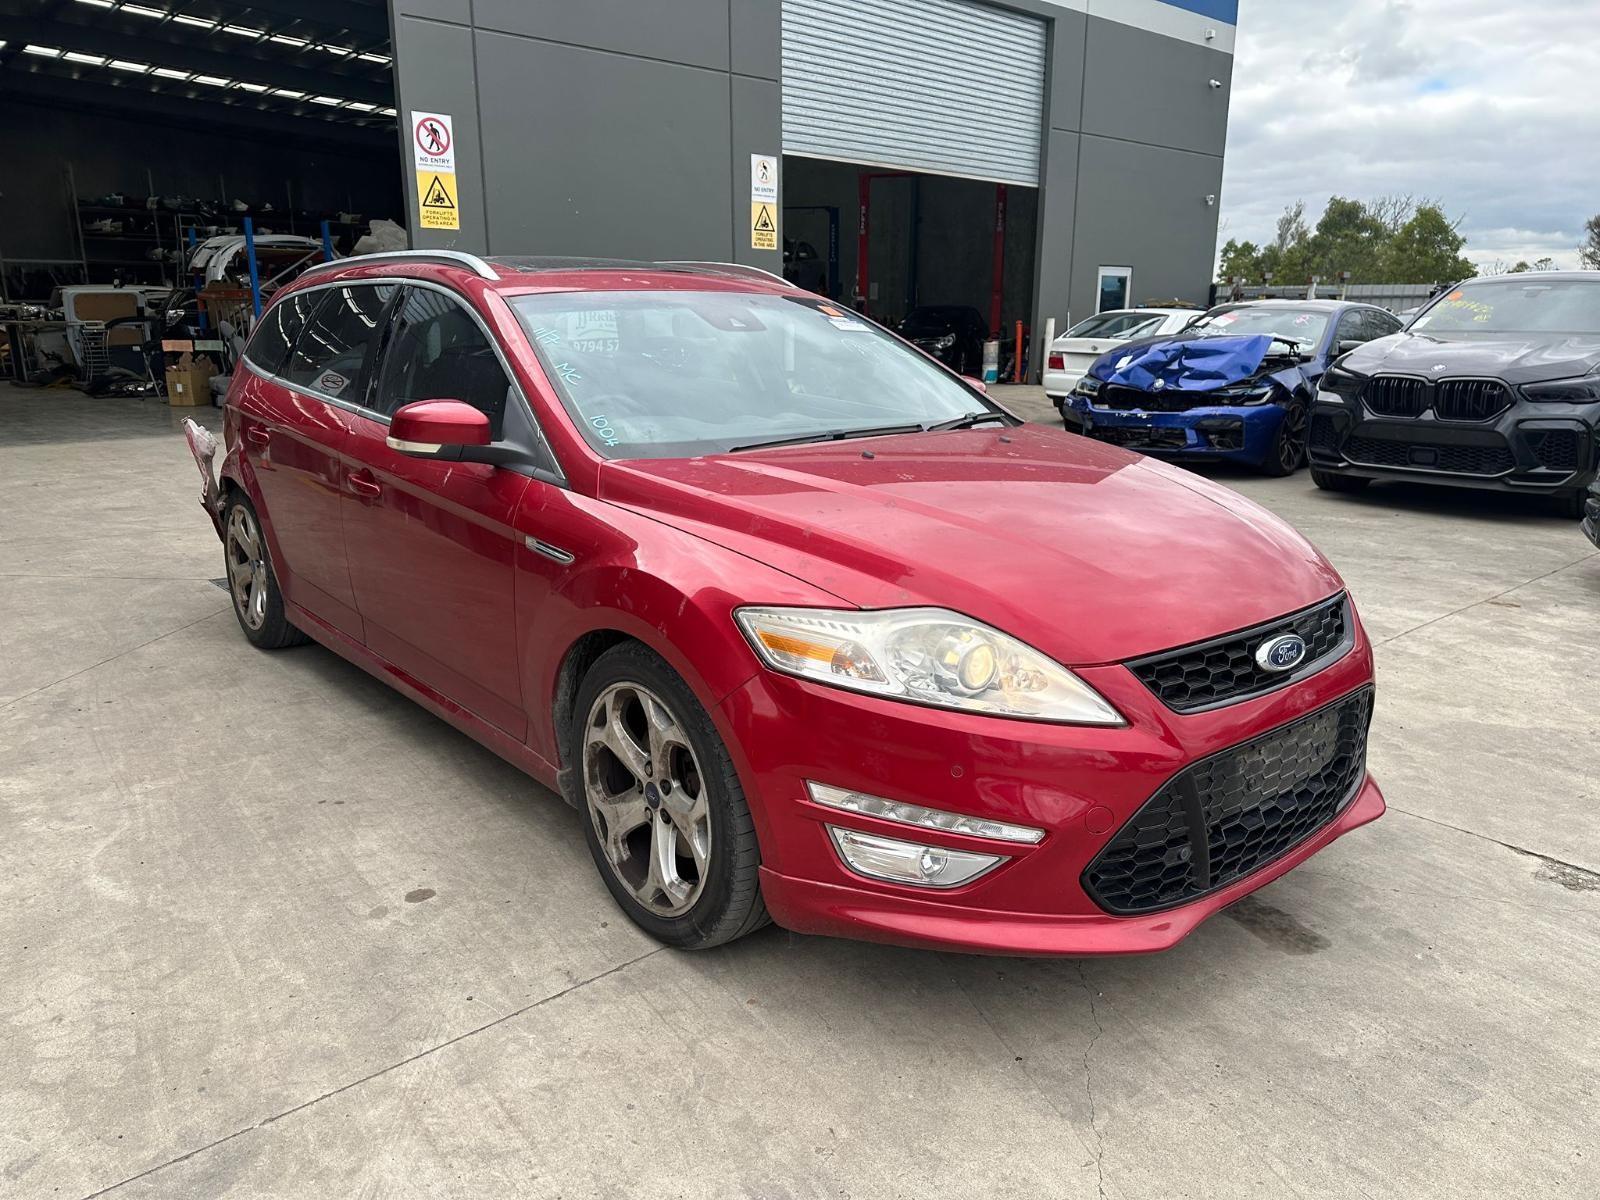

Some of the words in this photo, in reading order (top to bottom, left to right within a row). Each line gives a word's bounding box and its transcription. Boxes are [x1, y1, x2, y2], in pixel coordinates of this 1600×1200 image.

[430, 157, 450, 165] ENTRY
[554, 362, 583, 386] MC
[1278, 643, 1298, 664] Ford
